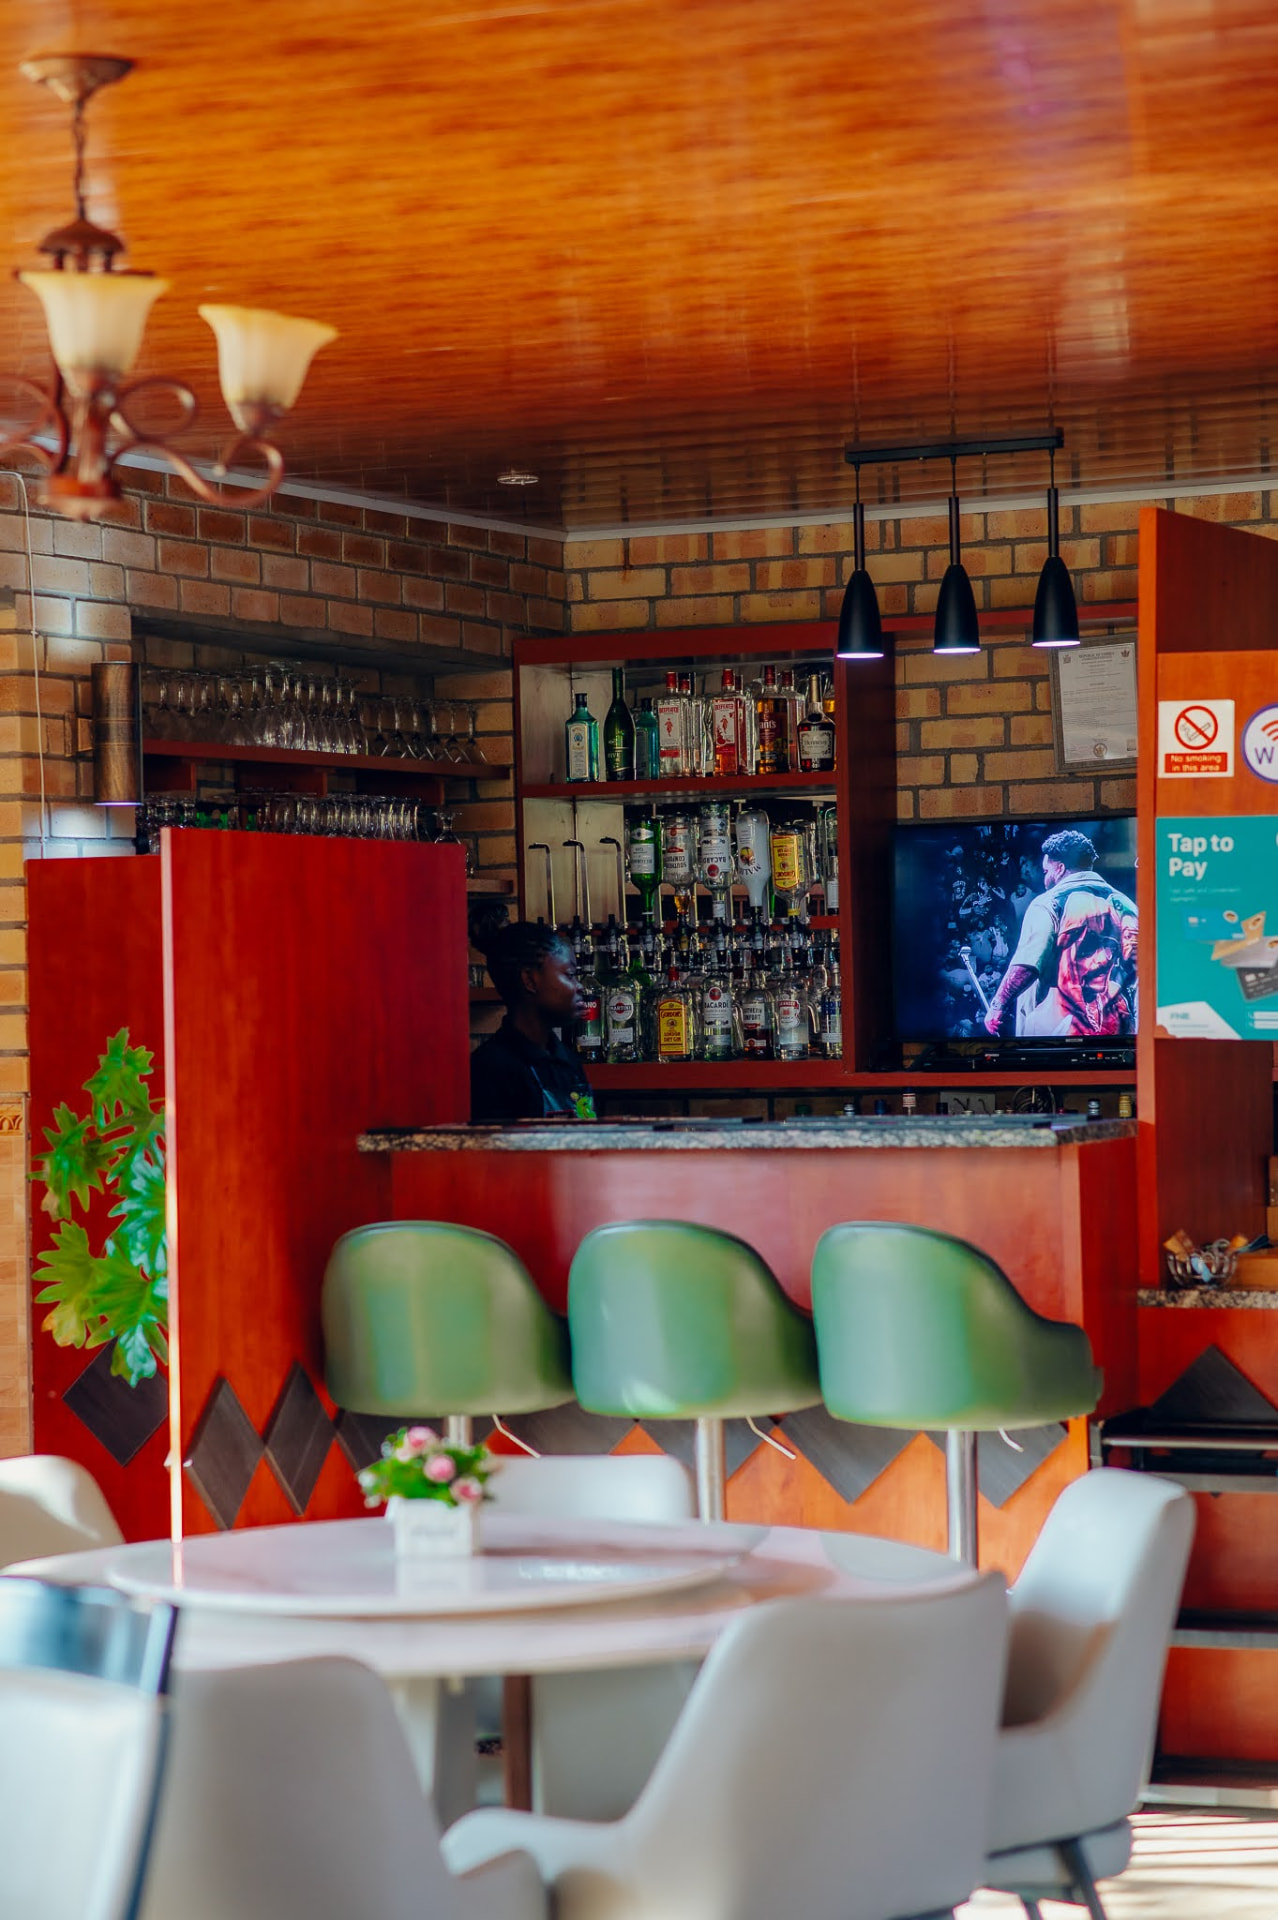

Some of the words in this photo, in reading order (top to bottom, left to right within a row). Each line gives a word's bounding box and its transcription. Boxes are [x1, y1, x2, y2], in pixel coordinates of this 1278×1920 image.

[1170, 755, 1183, 763] No
[1186, 755, 1222, 764] smoking
[1182, 764, 1198, 772] this
[1200, 764, 1220, 772] area
[1167, 833, 1208, 857] Tap
[1210, 834, 1234, 852] to
[1169, 857, 1208, 881] Pay
